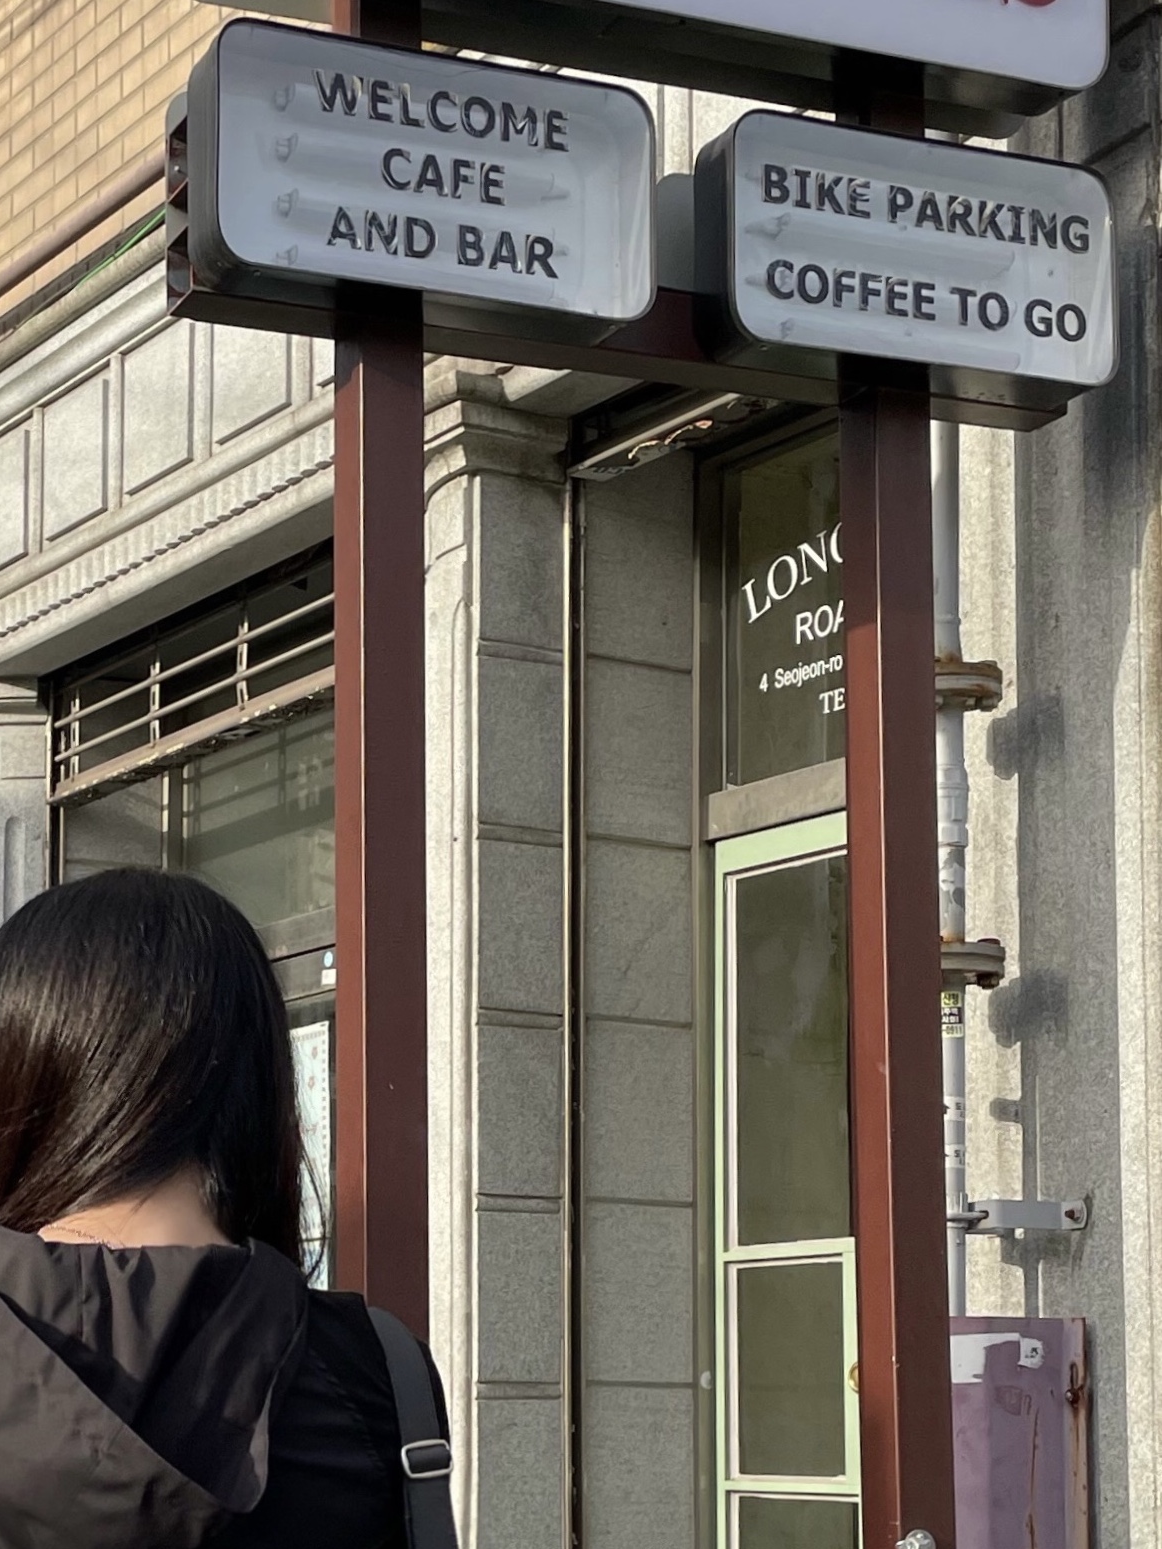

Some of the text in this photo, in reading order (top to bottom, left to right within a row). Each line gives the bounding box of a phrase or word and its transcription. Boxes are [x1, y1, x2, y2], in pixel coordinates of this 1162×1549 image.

[313, 68, 570, 153] WELCOME
[381, 148, 506, 206] CAFE
[761, 163, 1091, 254] BIKE PARKING
[326, 205, 559, 280] AND BAR
[766, 258, 1087, 343] COFFEE TO GO
[759, 654, 844, 692] 4 Seojeon-ro
